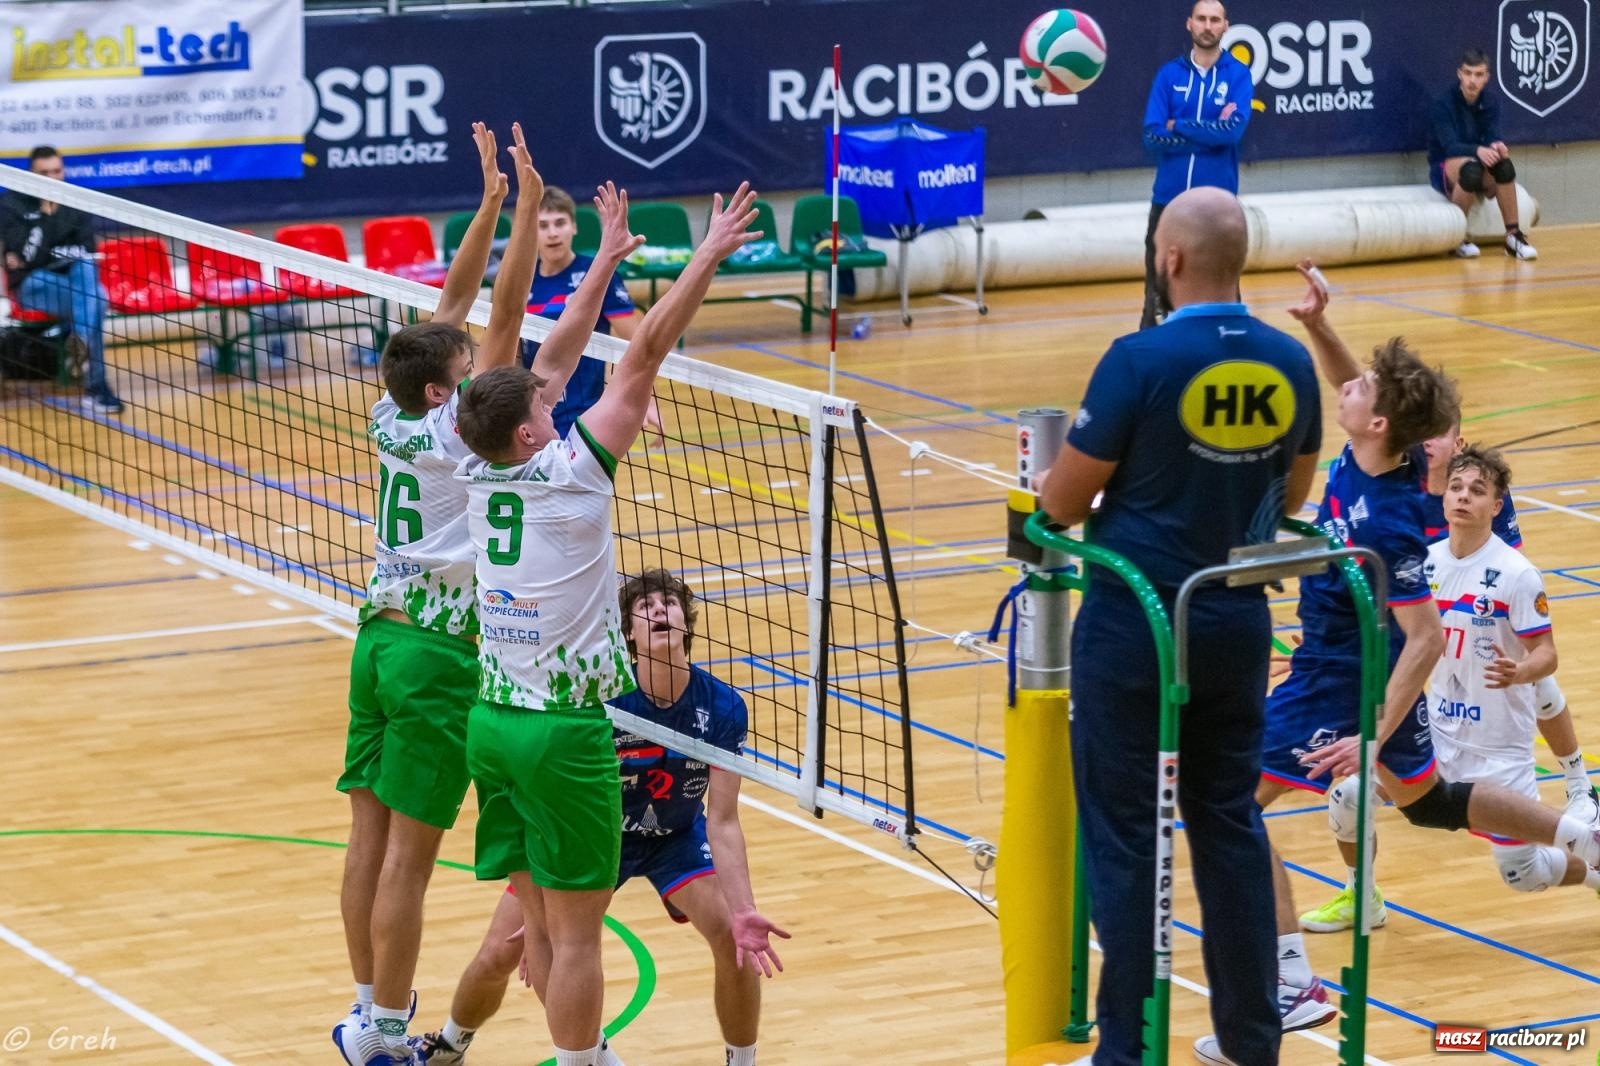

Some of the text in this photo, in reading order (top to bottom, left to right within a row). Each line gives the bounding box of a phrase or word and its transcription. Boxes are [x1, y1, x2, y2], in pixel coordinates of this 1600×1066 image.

[12, 21, 249, 74] instal-tech
[768, 42, 1078, 121] RACIBÓR
[1275, 87, 1374, 114] RACIBÓRZ
[327, 138, 448, 168] RACIBÓRZ
[918, 162, 977, 189] molten
[822, 405, 845, 417] netex
[1202, 385, 1279, 427] HK
[486, 491, 524, 566] 9
[512, 600, 538, 609] MULTI
[485, 623, 540, 640] ENTECO
[873, 818, 898, 833] netex
